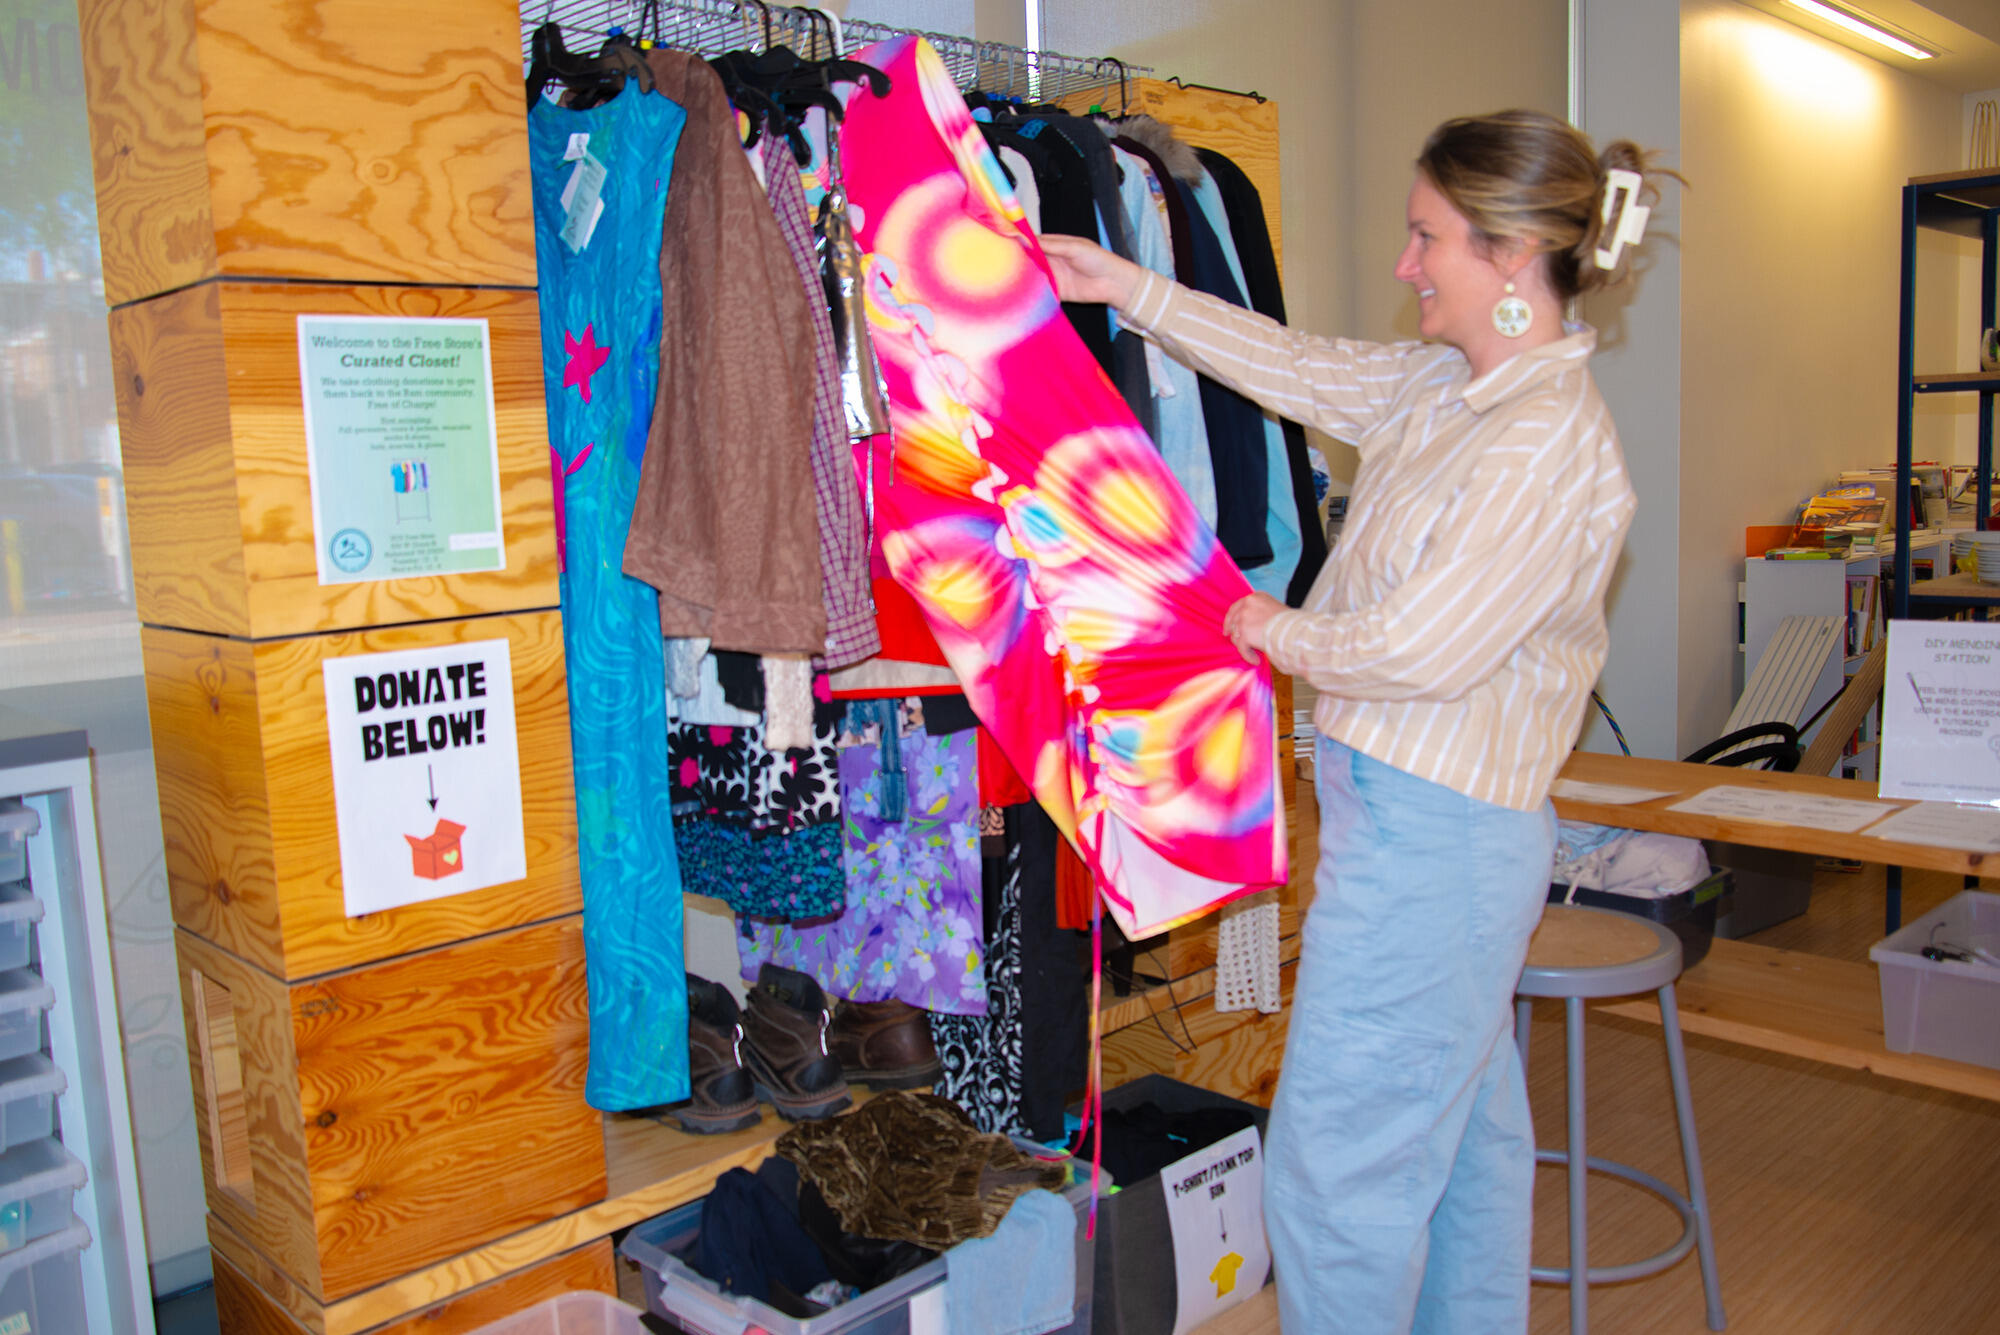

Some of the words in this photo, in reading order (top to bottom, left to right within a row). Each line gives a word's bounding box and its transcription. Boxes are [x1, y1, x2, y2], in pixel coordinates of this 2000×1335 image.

[312, 336, 374, 349] Welcome
[377, 338, 389, 349] to
[392, 337, 412, 349] the
[414, 337, 442, 350] Free
[444, 337, 483, 349] Store's
[340, 354, 404, 368] Curated
[408, 354, 461, 368] Closet!
[1924, 638, 1947, 649] DIY
[1934, 653, 1991, 665] STATION
[354, 661, 487, 713] DONATE
[1942, 718, 1990, 728] TUTORIALS
[362, 709, 486, 762] BELOW!
[1173, 1155, 1238, 1198] T-SHIRT/TANK
[1237, 1146, 1255, 1166] TOP
